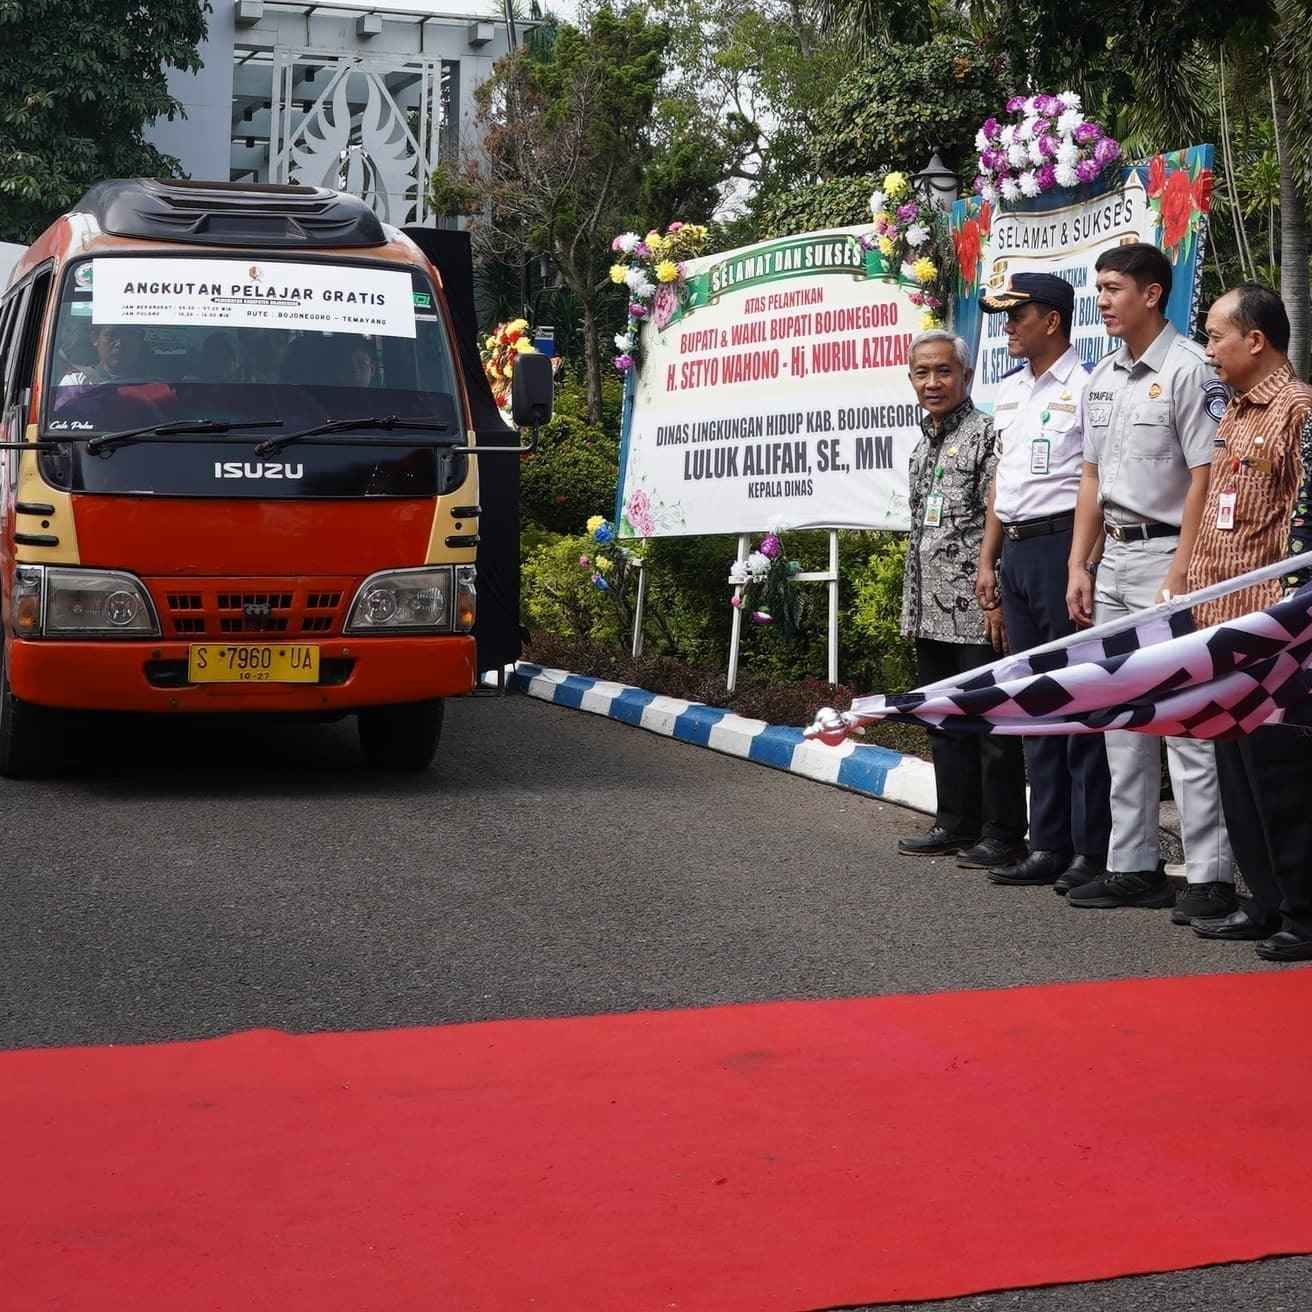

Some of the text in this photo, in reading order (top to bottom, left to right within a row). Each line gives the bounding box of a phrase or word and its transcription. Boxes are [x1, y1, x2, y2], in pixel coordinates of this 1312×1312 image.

[998, 198, 1134, 250] SELAMAT & SUKSES
[711, 243, 862, 291] SELAMAT DAN SUKSES
[123, 282, 386, 305] ANGKUTAN PELAJAR GRATIS
[744, 287, 824, 315] ATAS PELANTIKAN
[247, 310, 269, 318] RUTE
[277, 311, 331, 321] BOJONEGORO
[342, 316, 387, 326] TEMAYANG
[680, 302, 898, 354] BUPATI & WAKIL BUPATI BOJONEGORO
[666, 363, 678, 392] H.
[680, 356, 719, 390] SETYO
[721, 348, 780, 384] WAHONO
[790, 345, 809, 378] Hj.
[812, 339, 859, 375] NURUL
[861, 333, 913, 370] AZIZAH
[1088, 391, 1114, 402] SYAIFUL
[656, 403, 924, 447] DINAS LINGKUNGAN HIDUP KAB. BOJONEGORO
[214, 461, 304, 480] ISUZU
[683, 435, 894, 481] LULUK ALIFAH, SE., MM
[747, 478, 814, 499] KEPALA DINAS
[197, 647, 313, 670] S 7960 UA
